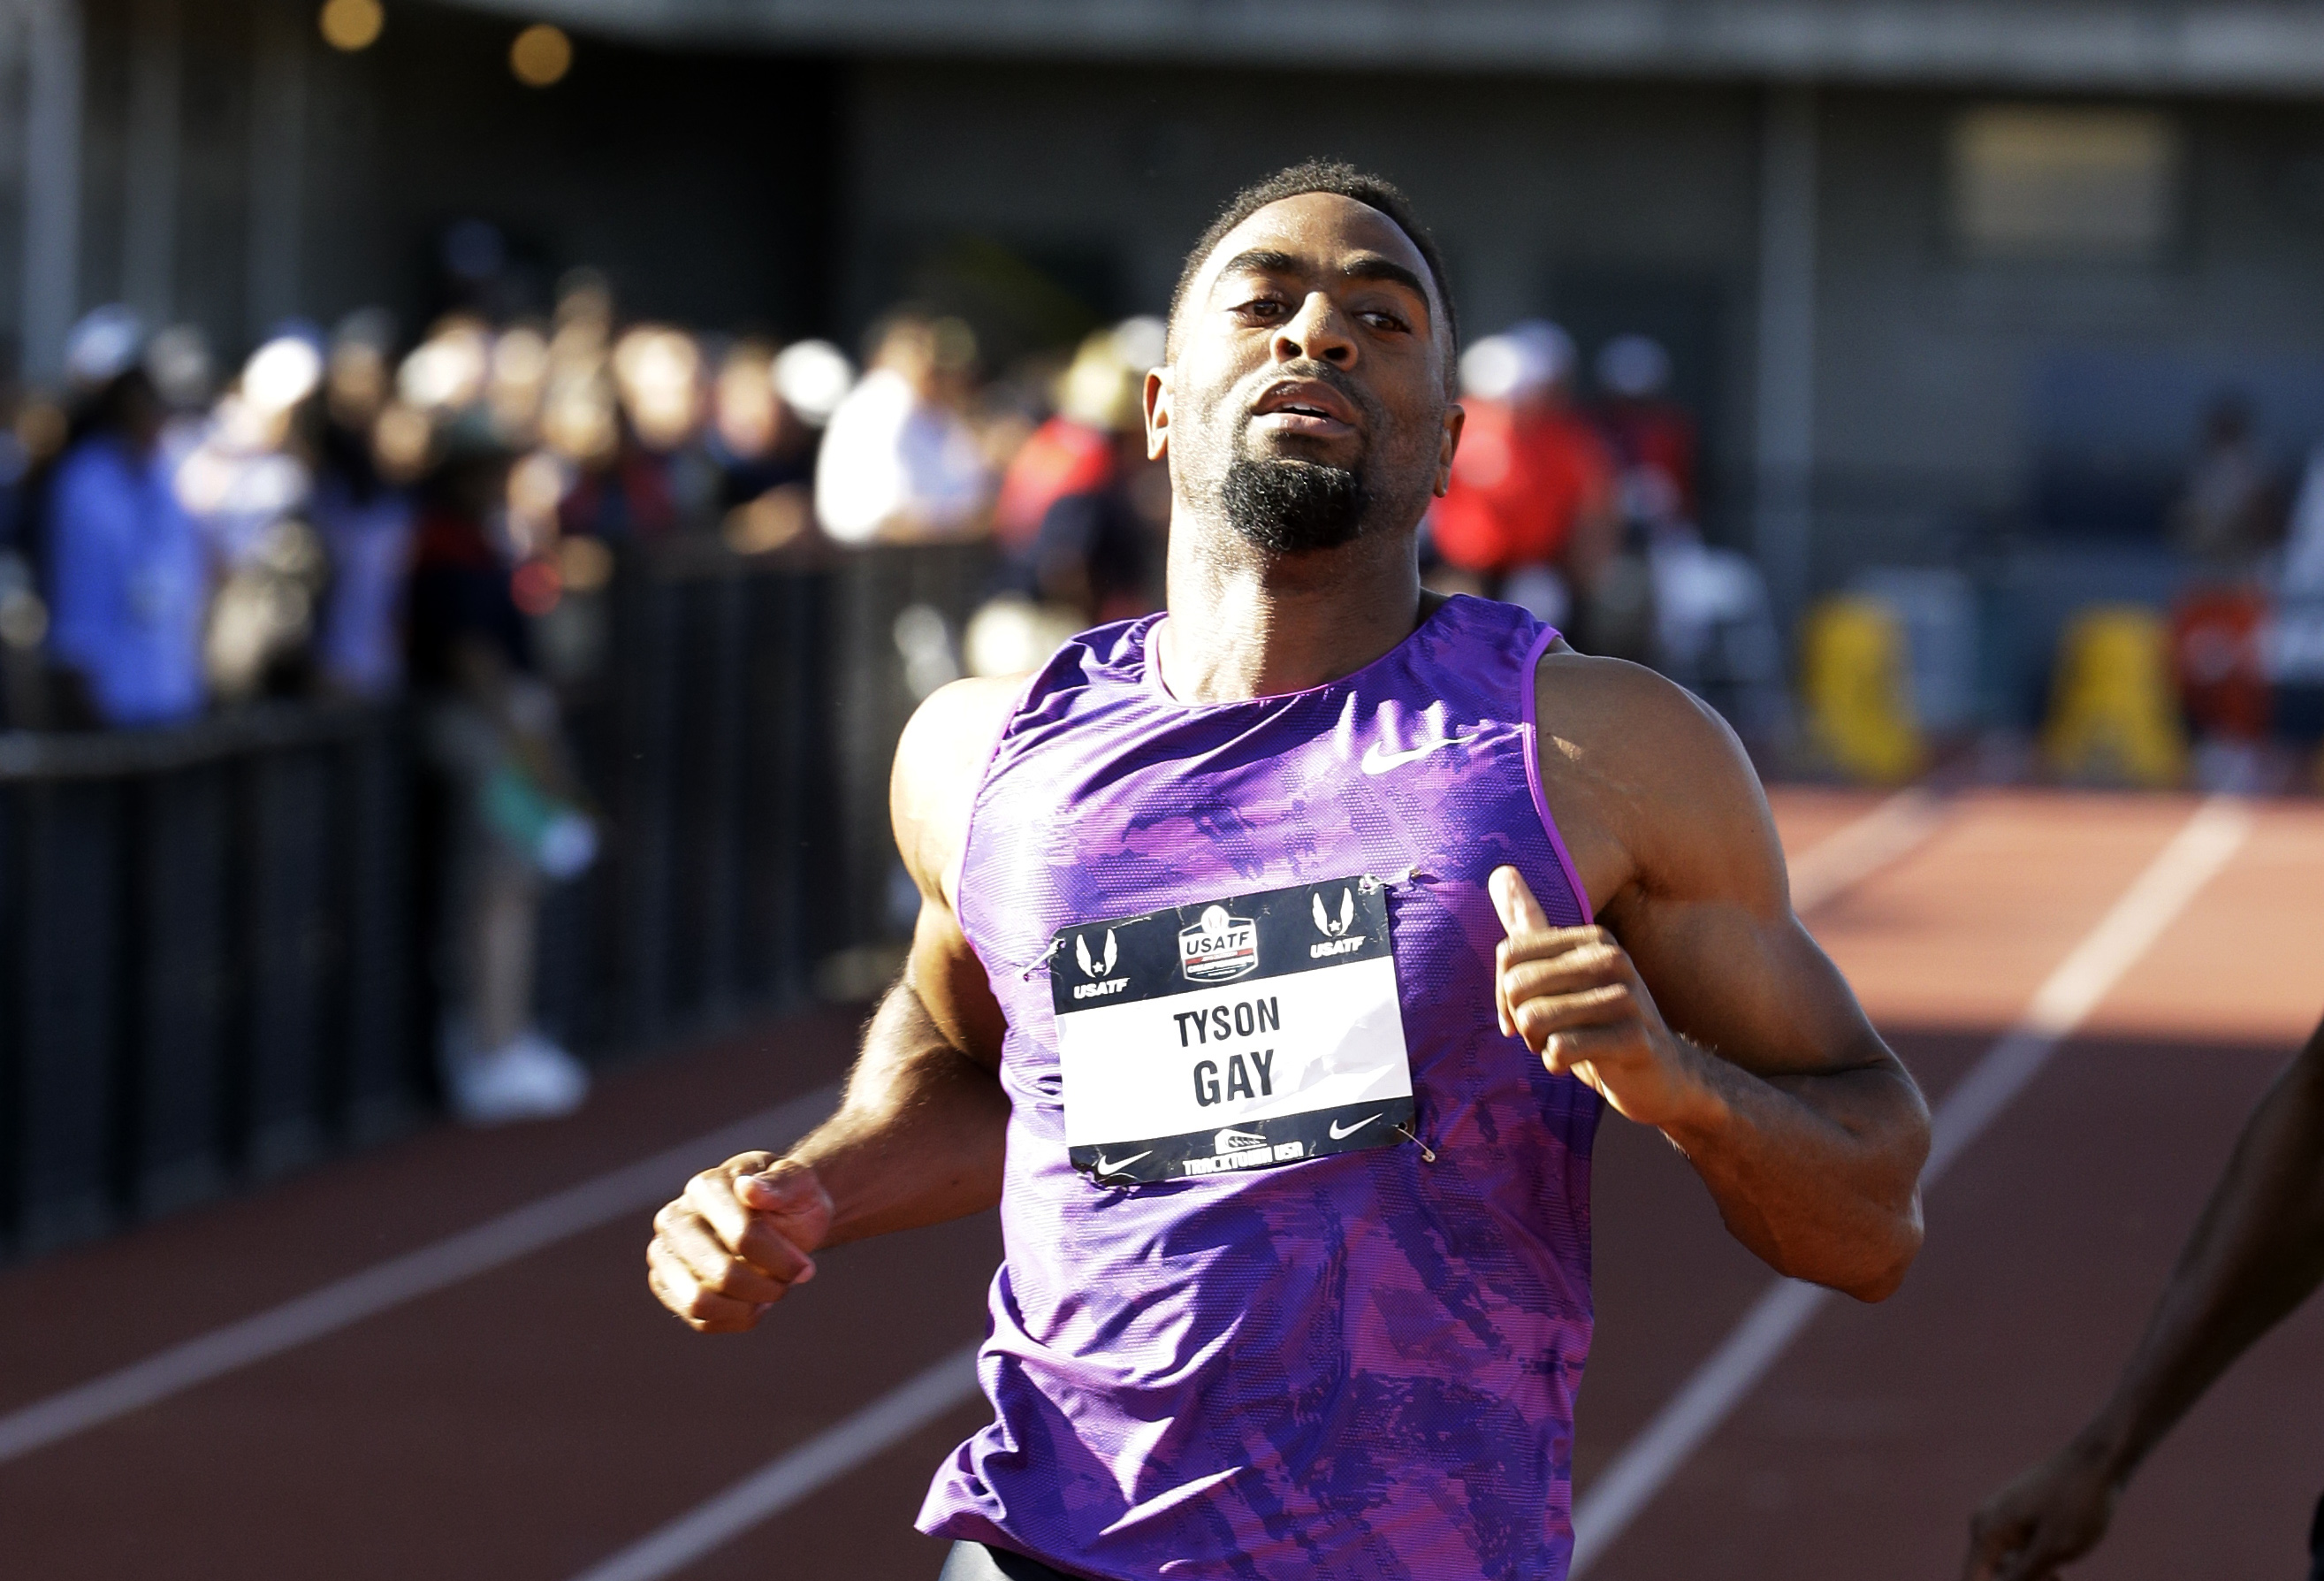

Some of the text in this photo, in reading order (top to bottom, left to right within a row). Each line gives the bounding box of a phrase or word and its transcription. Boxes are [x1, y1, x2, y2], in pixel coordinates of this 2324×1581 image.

[1186, 931, 1250, 956] USATF
[1310, 936, 1367, 959] USATF
[1073, 977, 1131, 999] USATF
[1173, 996, 1280, 1048] TYSON
[1193, 1049, 1274, 1107] GAY
[1273, 1141, 1304, 1161] USA
